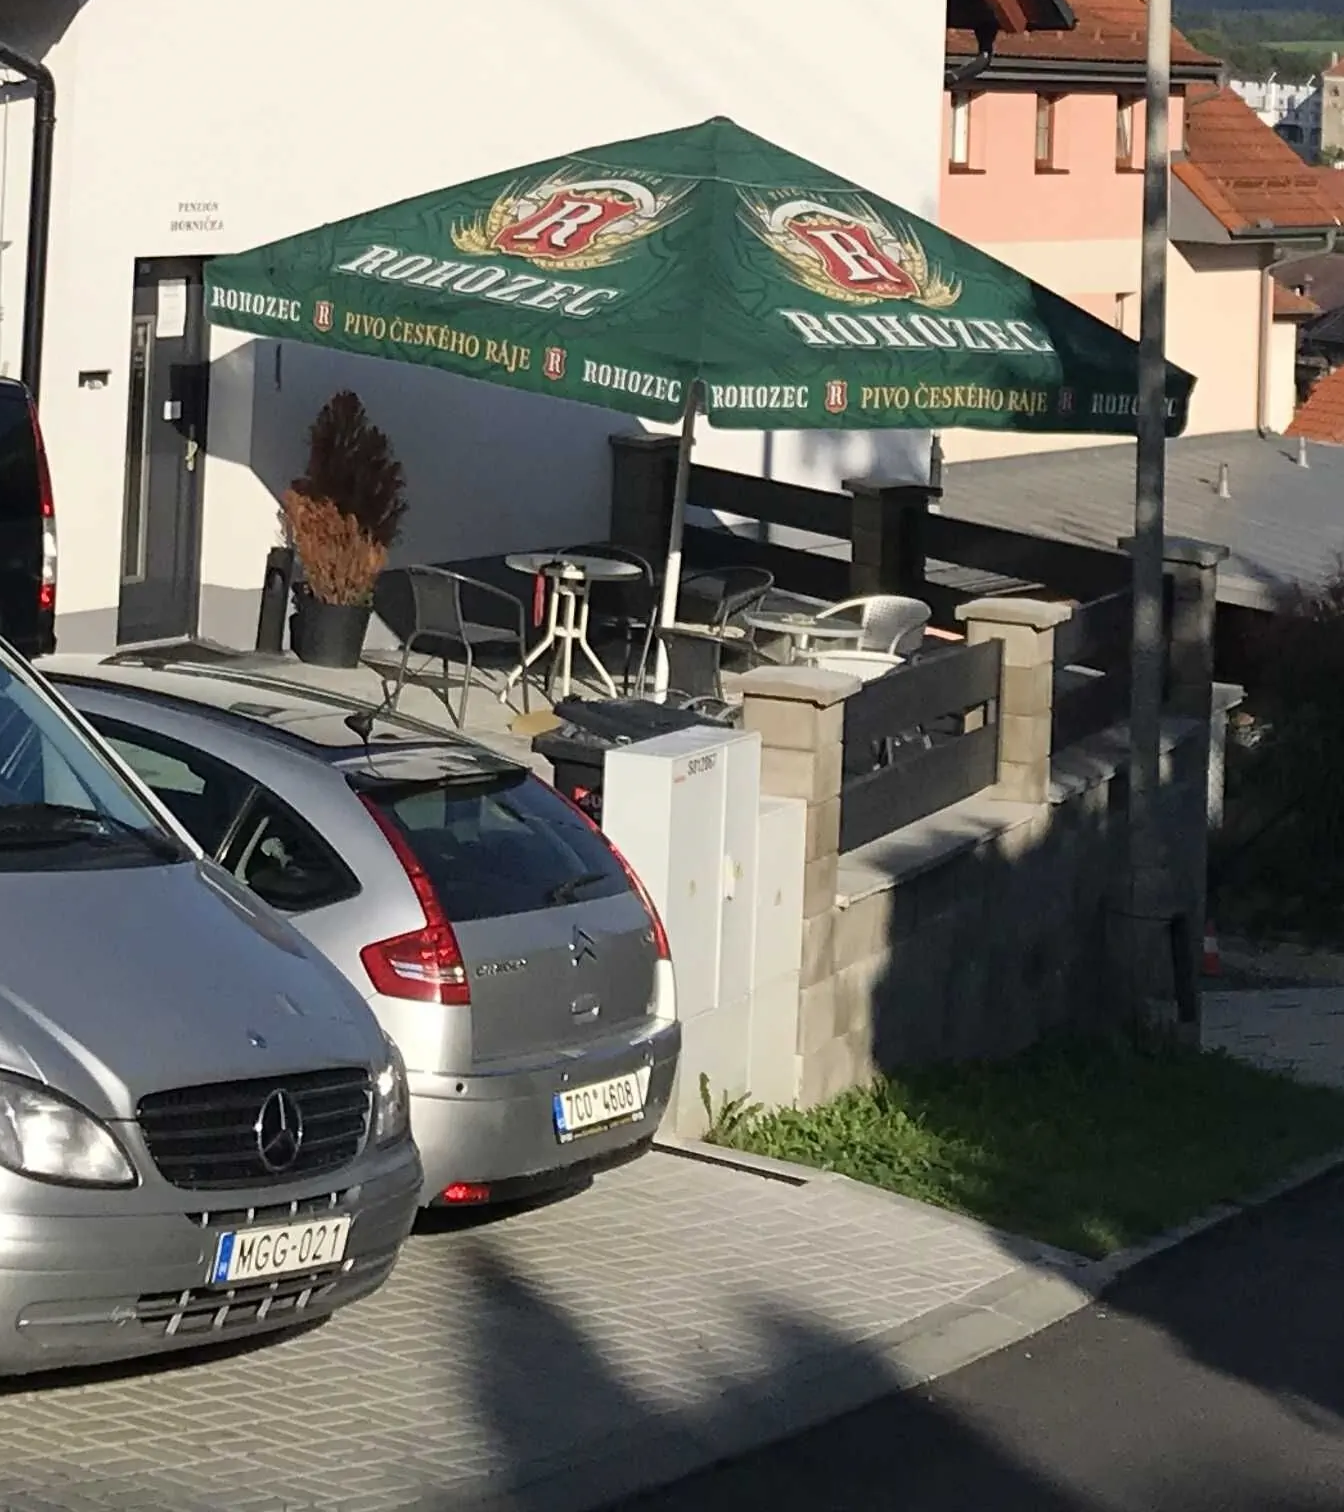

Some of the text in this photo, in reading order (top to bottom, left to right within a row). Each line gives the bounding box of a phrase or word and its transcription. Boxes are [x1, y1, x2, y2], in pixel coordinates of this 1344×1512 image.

[513, 201, 603, 247] R
[808, 229, 901, 283] R
[338, 244, 620, 318] ROHOZEC
[211, 286, 301, 322] ROHOZEC
[344, 311, 386, 339] PIVO
[390, 317, 480, 358] ČESKÉHO
[485, 339, 530, 372] RÁJE
[582, 359, 682, 403] ROHOZEC
[779, 310, 1055, 353] ROHOZEC
[712, 385, 809, 408] ROHOZEC
[862, 387, 910, 409] PIVO
[914, 382, 1003, 410] ČESKÉHO
[1008, 389, 1048, 417] RÁJE
[602, 1080, 634, 1112] 4608
[236, 1224, 341, 1274] MGG-021
